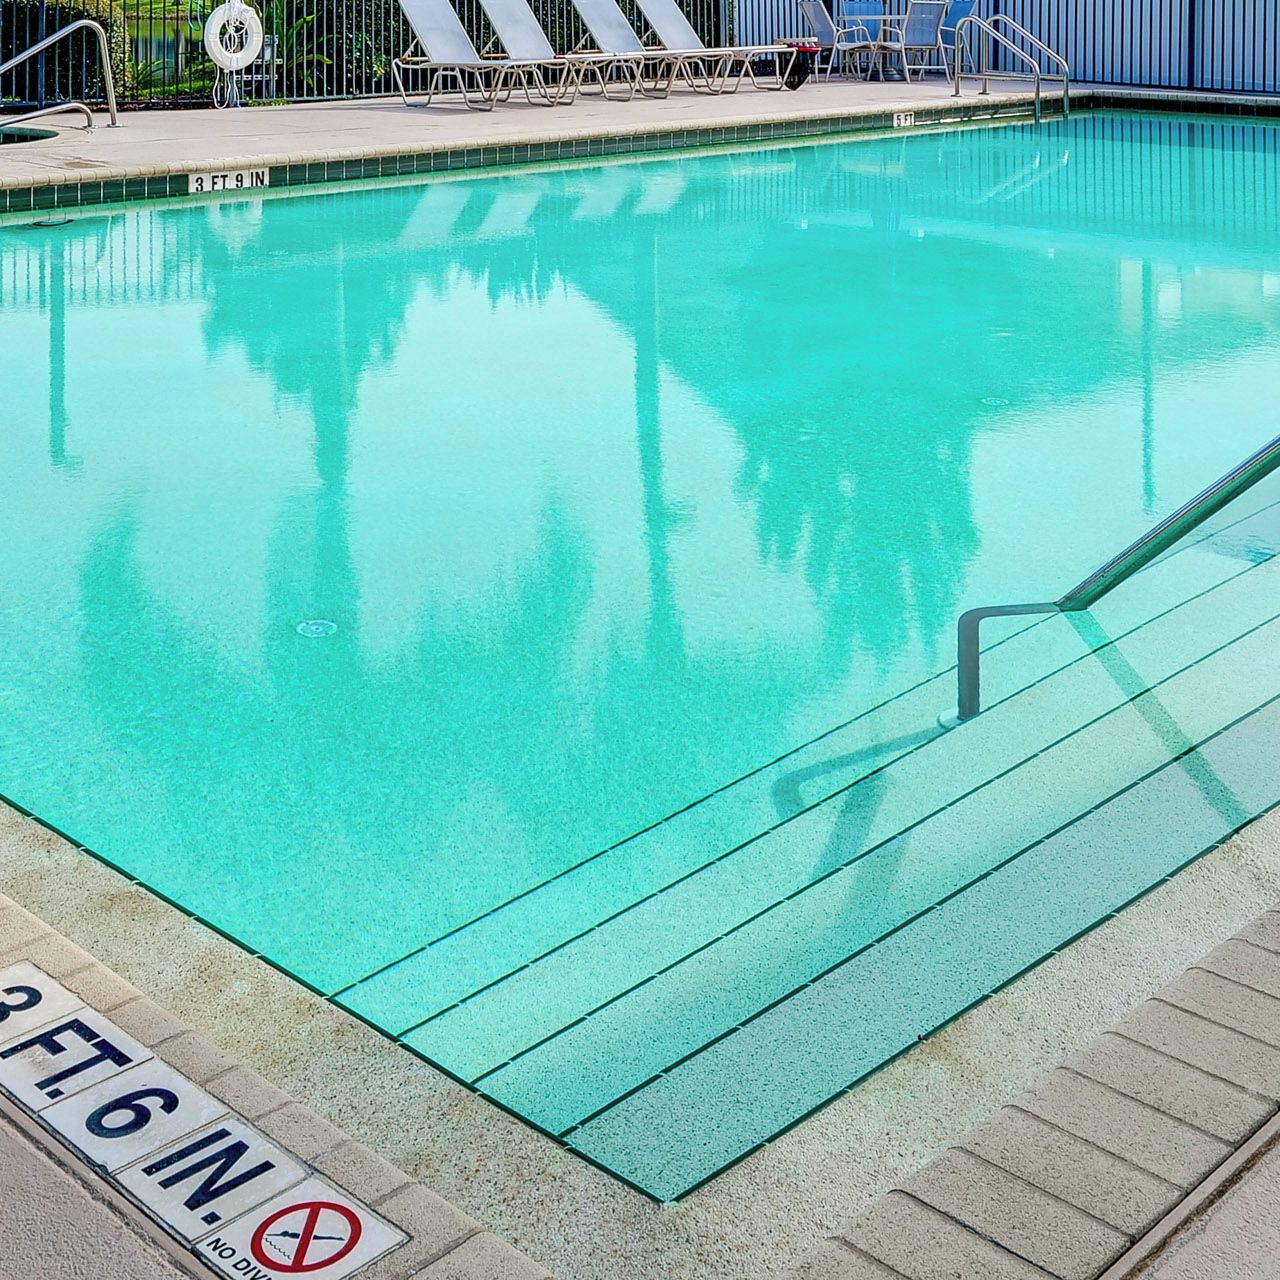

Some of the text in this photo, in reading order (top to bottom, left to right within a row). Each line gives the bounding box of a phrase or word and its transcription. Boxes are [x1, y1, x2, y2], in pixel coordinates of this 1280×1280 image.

[904, 113, 913, 126] FT
[195, 176, 204, 192] 3
[235, 173, 244, 188] 9
[85, 1087, 180, 1139] 6
[141, 1127, 276, 1226] IN.
[206, 1237, 237, 1260] NO
